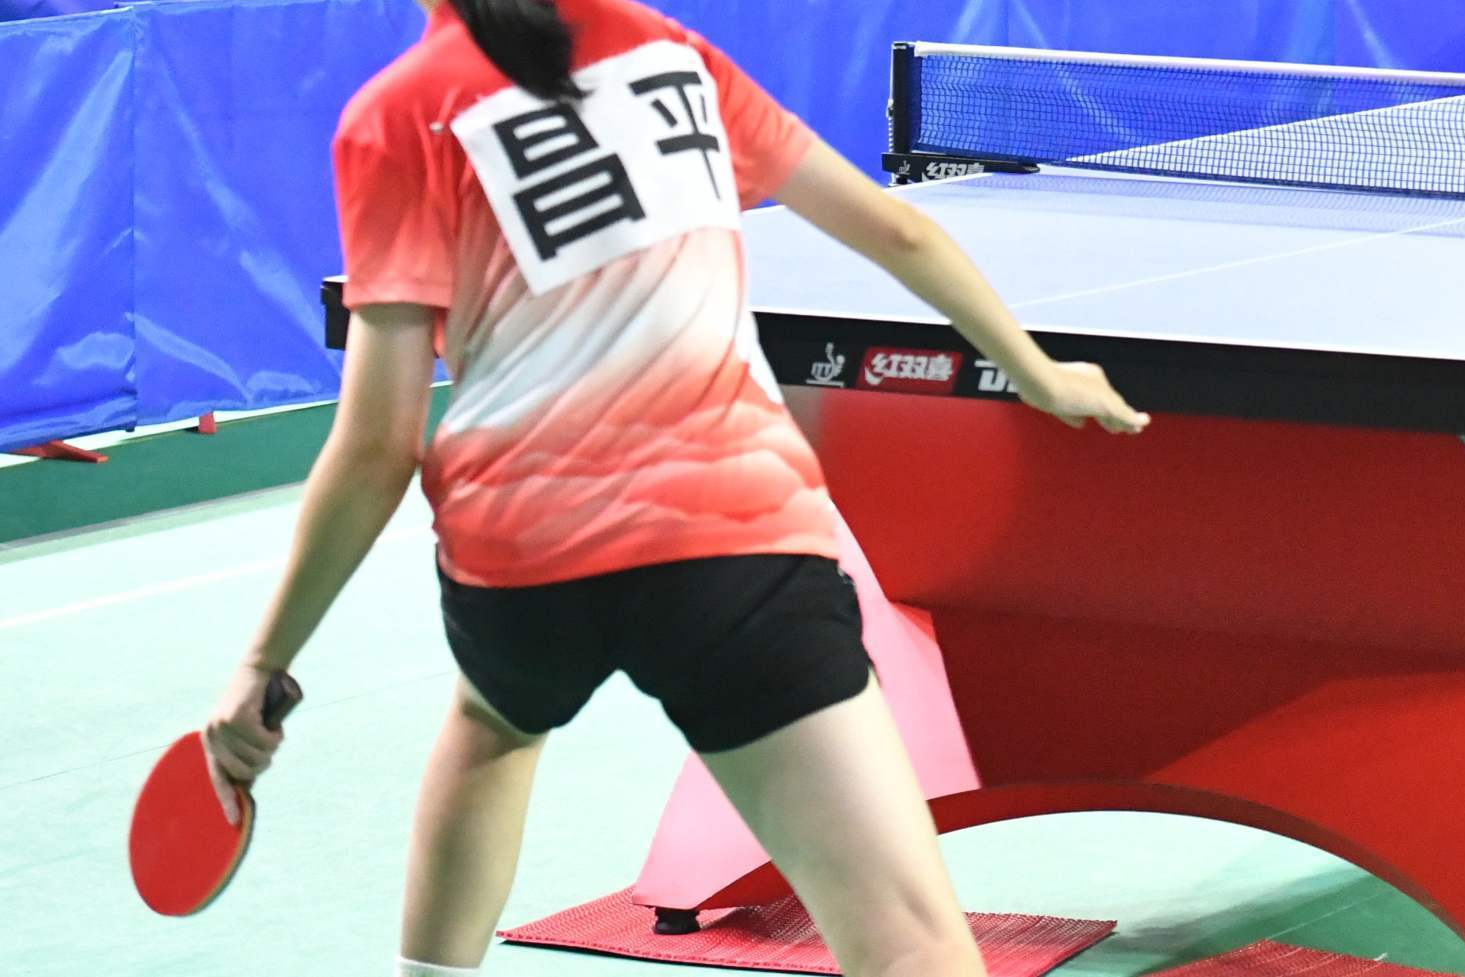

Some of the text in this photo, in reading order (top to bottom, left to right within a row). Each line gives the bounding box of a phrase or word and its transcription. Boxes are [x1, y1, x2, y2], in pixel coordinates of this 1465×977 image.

[491, 70, 721, 263] 昌平
[864, 352, 955, 385] 红双喜
